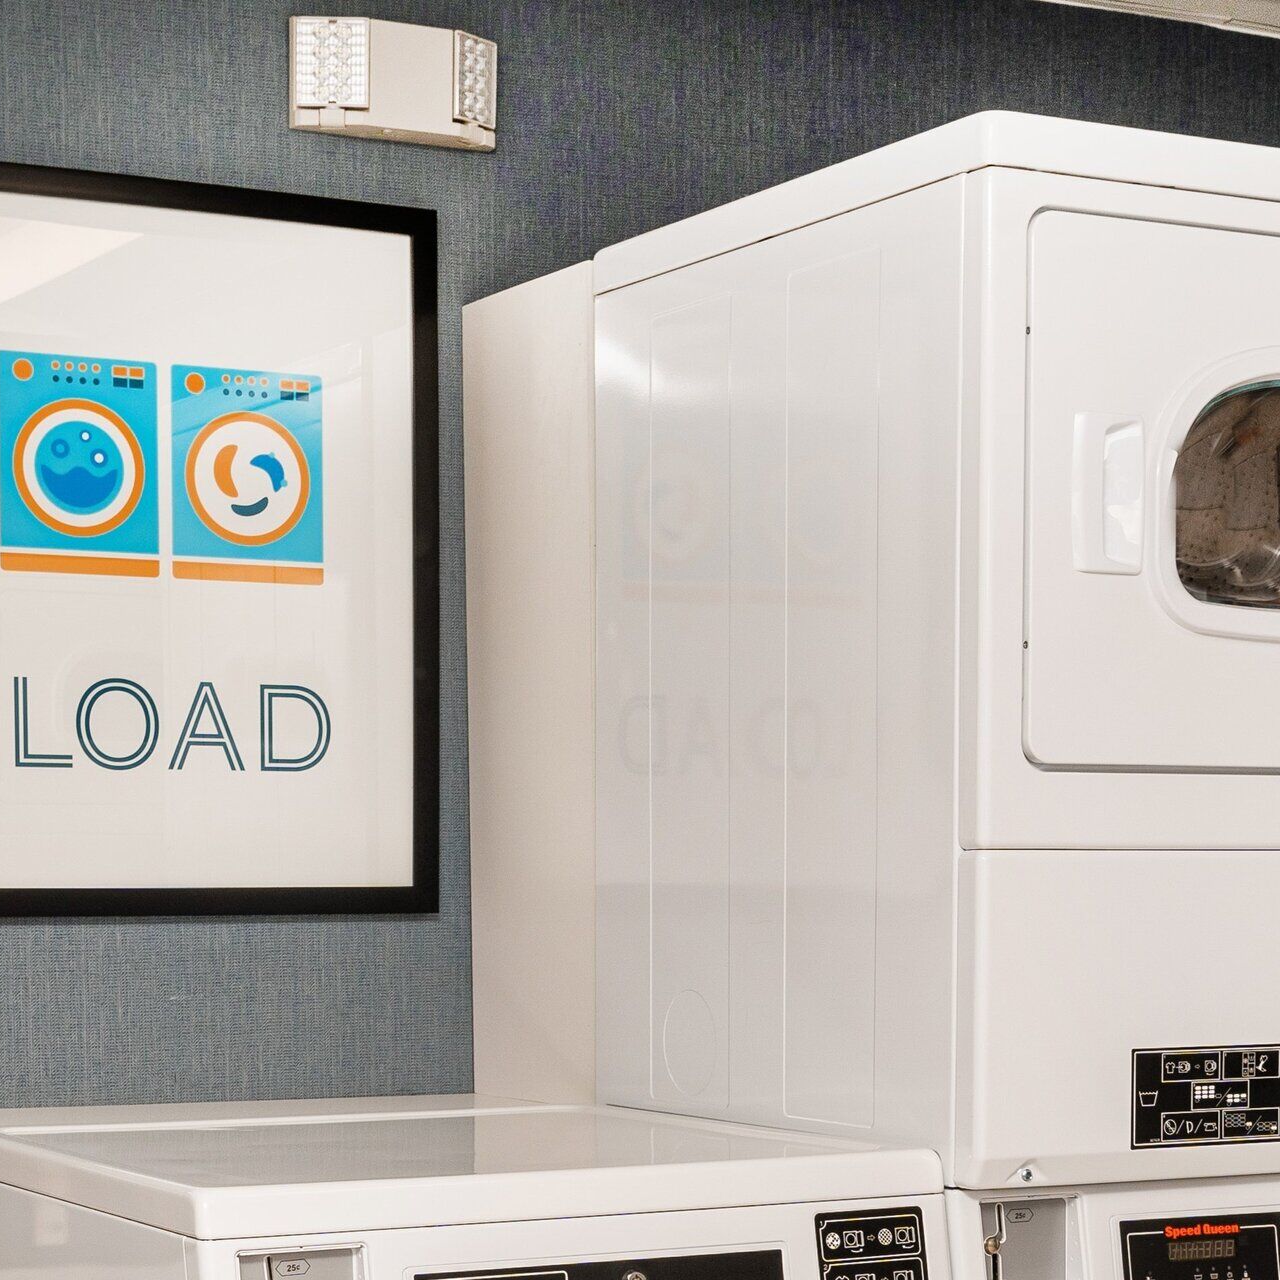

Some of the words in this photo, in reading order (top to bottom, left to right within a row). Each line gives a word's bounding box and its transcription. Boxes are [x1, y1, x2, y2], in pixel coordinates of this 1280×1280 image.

[13, 676, 332, 773] LOAD
[1165, 1225, 1200, 1238] Speed
[1203, 1223, 1239, 1234] Queen
